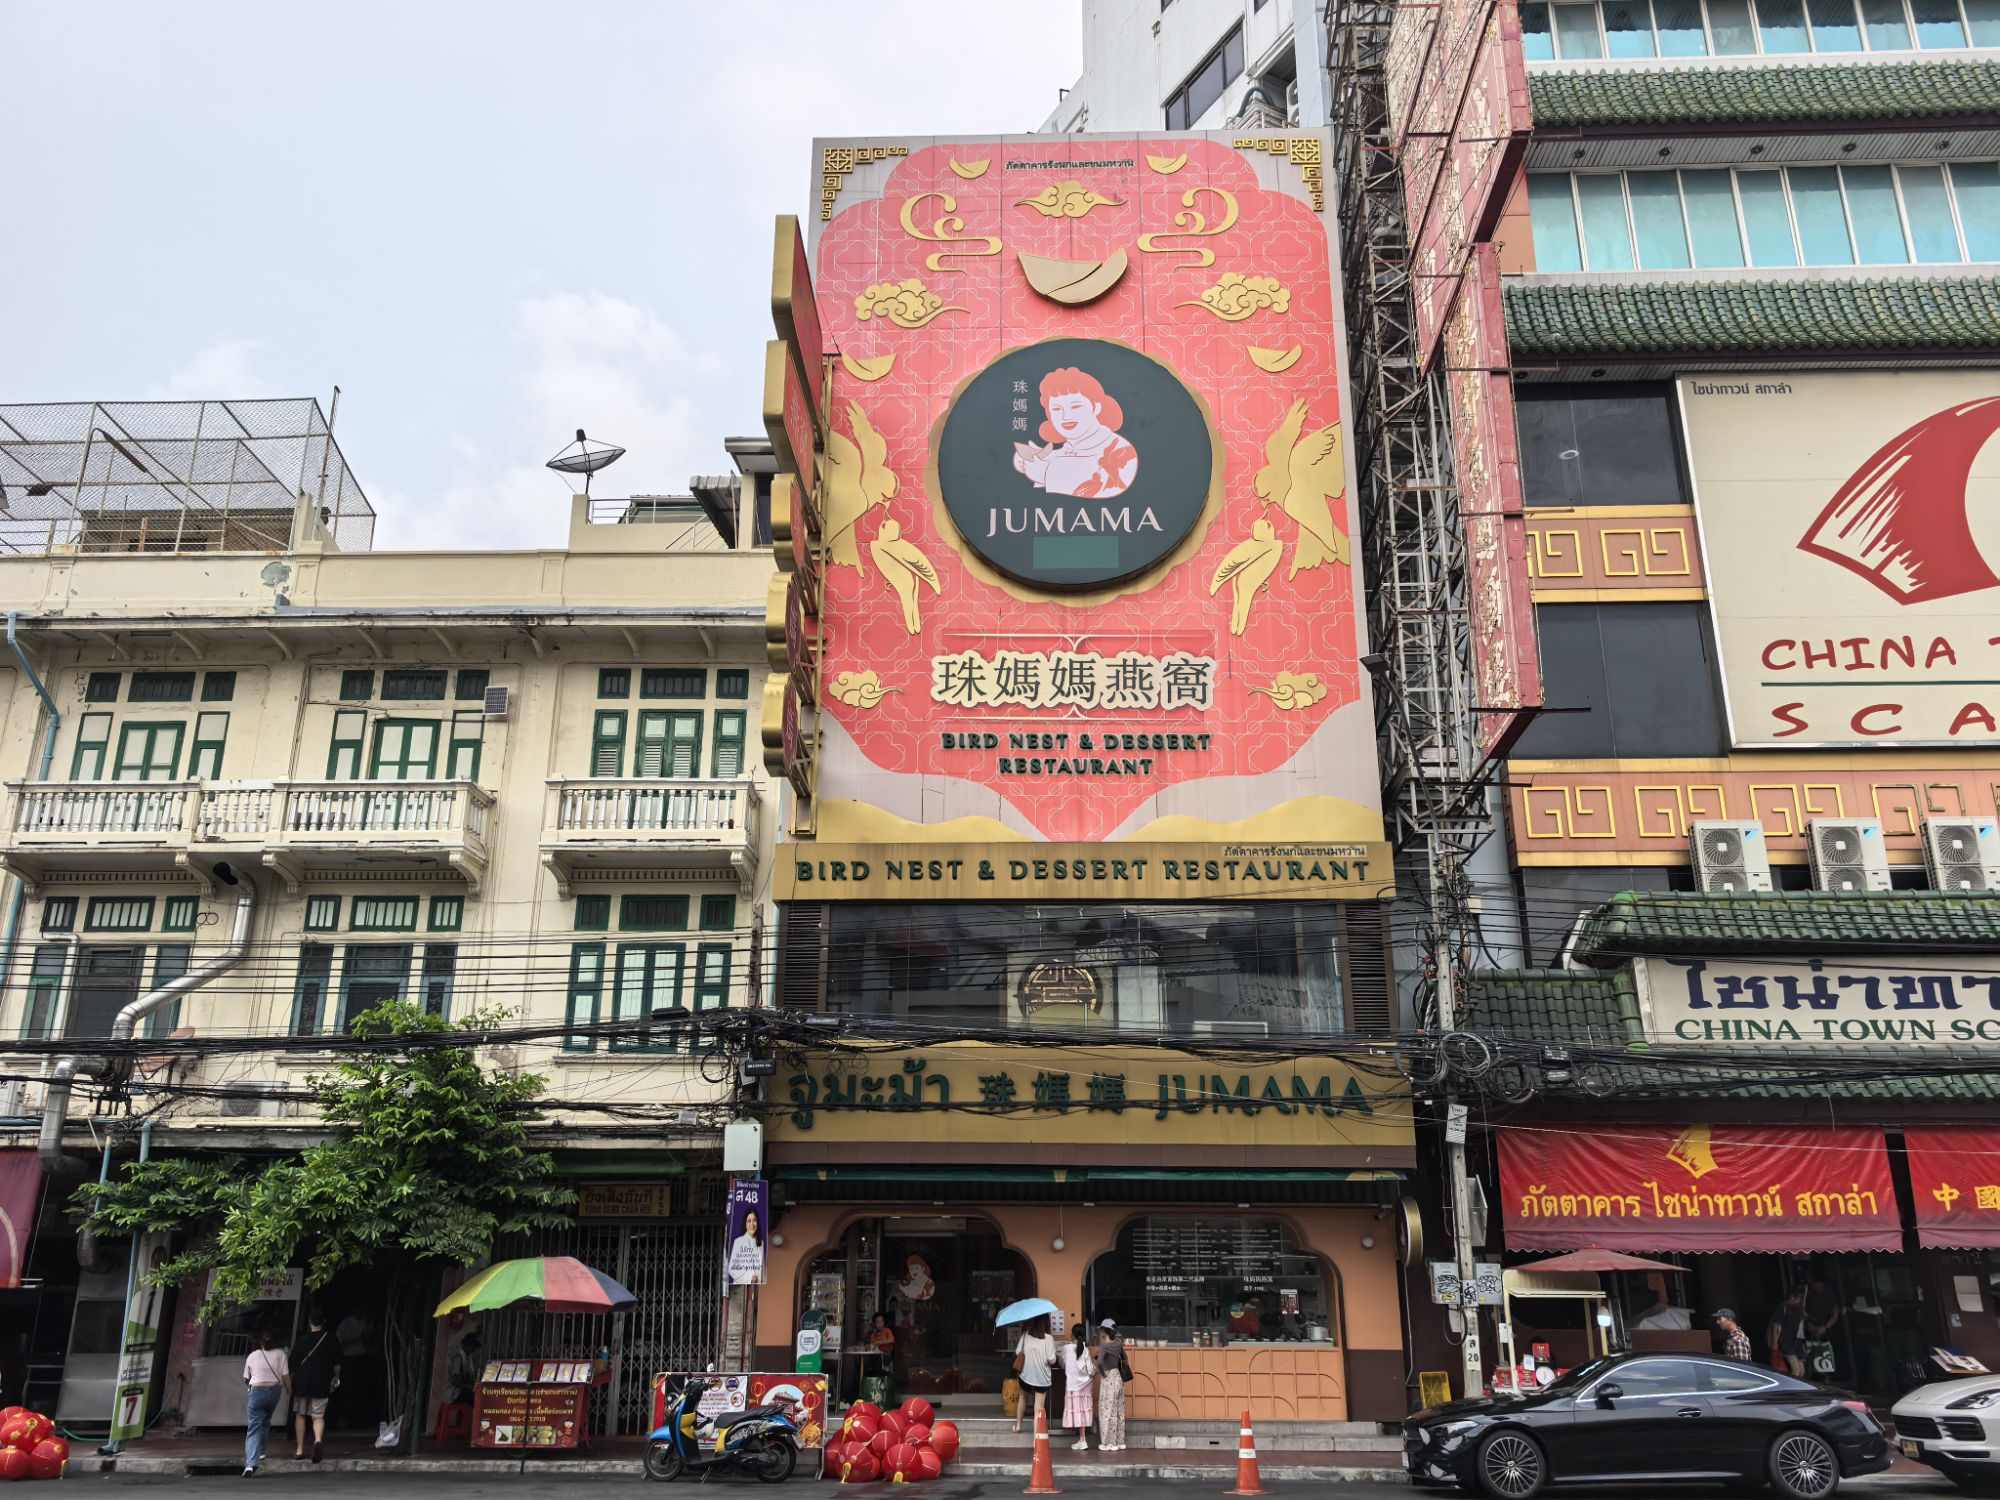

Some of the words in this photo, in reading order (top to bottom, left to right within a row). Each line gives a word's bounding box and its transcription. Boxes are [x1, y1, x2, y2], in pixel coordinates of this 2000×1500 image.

[1690, 381, 1749, 395] ไชน่าทาวน์
[1755, 382, 1792, 395] สกาล่า
[1012, 380, 1028, 431] 珠媽媽
[986, 506, 1164, 537] JUMAMA
[1761, 635, 1957, 671] CHINA
[936, 656, 1212, 705] 珠媽媽燕窩
[941, 733, 998, 749] BIRD
[1010, 733, 1068, 749] NEST
[1080, 733, 1094, 749] &
[1104, 733, 1212, 750] DESSERT
[999, 757, 1153, 775] RESTAURANT
[796, 861, 870, 881] BIRD
[886, 861, 963, 880] NEST
[978, 861, 995, 880] &
[1009, 860, 1148, 880] DESSERT
[1165, 860, 1369, 881] RESTAURANT
[1674, 1019, 1801, 1041] CHINA
[1814, 1019, 1935, 1041] TOWN
[788, 1057, 949, 1129] จูมะม้า
[1155, 1074, 1374, 1120] JUMAMA
[744, 1190, 758, 1204] 48
[1520, 1184, 1641, 1218] ภัตตาคาร
[1643, 1181, 1783, 1218] ไชน่าทาวน์
[1795, 1183, 1878, 1216] สกาล่า
[1468, 1353, 1479, 1362] 20
[125, 1396, 138, 1425] 7
